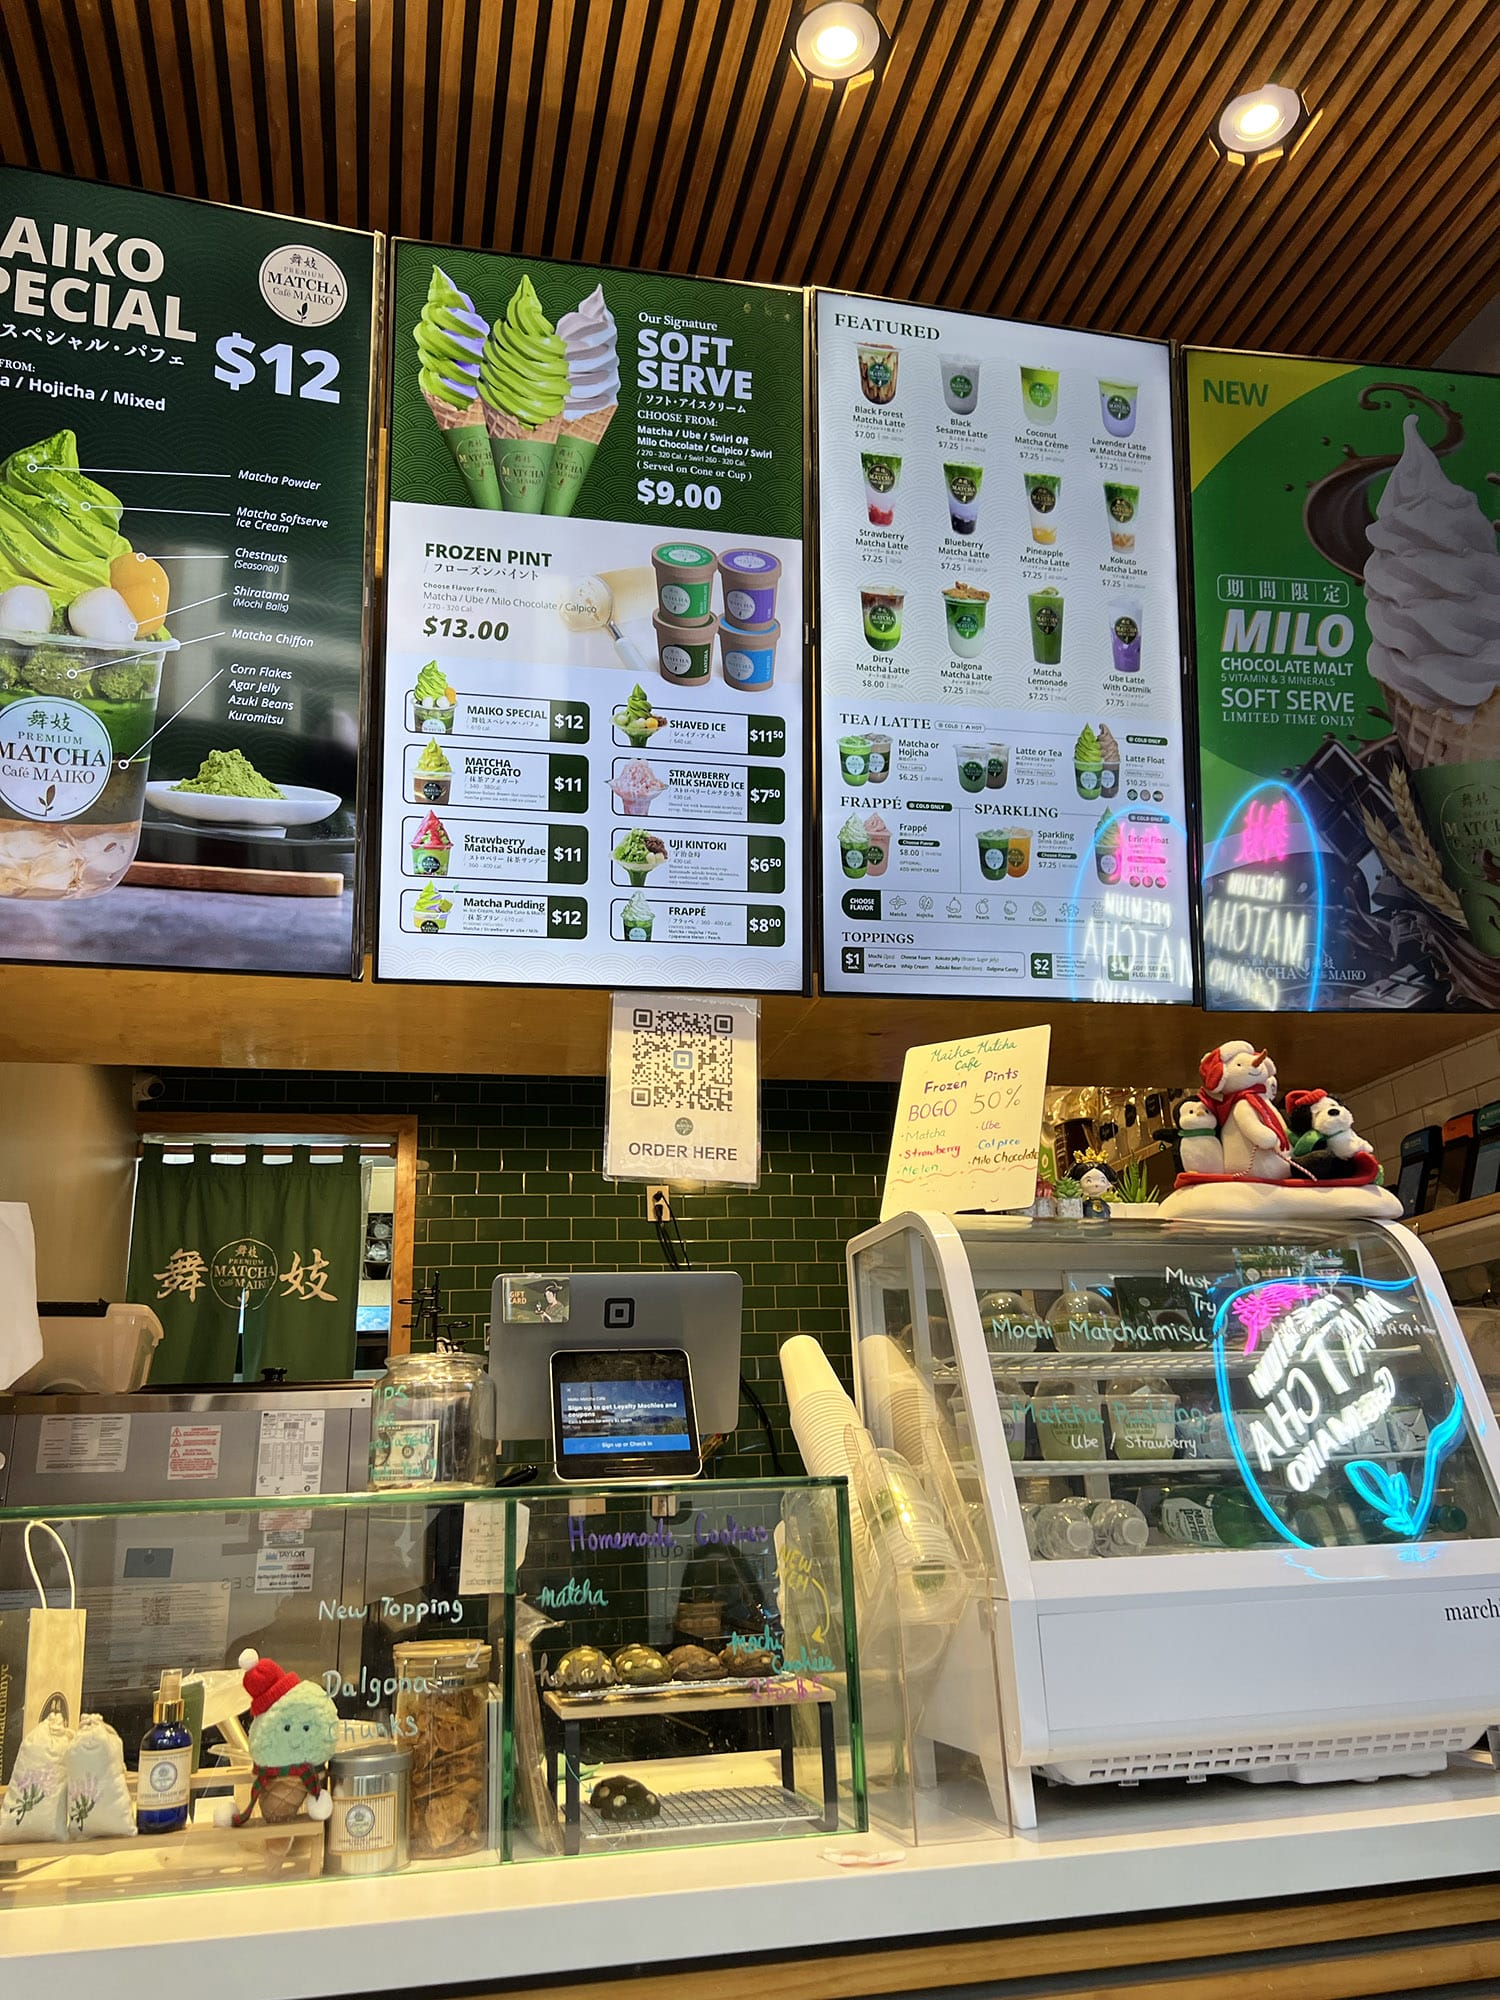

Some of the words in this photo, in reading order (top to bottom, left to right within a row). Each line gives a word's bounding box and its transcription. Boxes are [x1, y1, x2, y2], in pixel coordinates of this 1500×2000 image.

[283, 266, 324, 279] PREMIUM
[267, 271, 342, 297] MATCHA
[293, 290, 334, 306] MAIKO
[639, 312, 661, 324] Our
[664, 315, 718, 331] Signature
[835, 313, 940, 341] FEATURED
[637, 329, 733, 366] SOFT
[214, 332, 340, 404] $12
[637, 360, 752, 400] SERVE
[29, 378, 95, 401] Hojicha
[114, 390, 166, 412] Mixed
[1203, 378, 1269, 407] NEW
[855, 405, 877, 416] Black
[878, 409, 903, 419] Forest
[853, 415, 883, 426] Matcha
[884, 419, 906, 428] Latte
[950, 418, 971, 428] Black
[936, 426, 966, 437] Sesame
[967, 429, 988, 439] Latte
[1026, 428, 1057, 439] Coconut
[1092, 438, 1126, 449] Lavender
[1128, 442, 1147, 451] Latte
[238, 469, 279, 485] Matcha
[281, 475, 322, 490] Powder
[637, 478, 721, 510] $9.00
[236, 506, 277, 521] Matcha
[280, 510, 329, 529] Softserve
[236, 518, 252, 529] Ice
[254, 520, 289, 534] Cream
[859, 529, 905, 541] Strawberry
[855, 538, 886, 548] Matcha
[888, 542, 909, 551] Latte
[944, 538, 983, 550] Blueberry
[235, 548, 289, 564] Chestnuts
[425, 543, 501, 563] FROZEN
[507, 550, 552, 567] PINT
[1020, 556, 1048, 565] Matcha
[1050, 559, 1070, 568] Latte
[234, 558, 280, 574] (Seasonal)
[1099, 564, 1127, 574] Matcha
[1128, 567, 1148, 576] Latte
[233, 586, 290, 602] Shiratama
[232, 598, 264, 611] (Mochi
[265, 601, 289, 614] Balls)
[423, 615, 509, 642] $13.00
[1221, 608, 1354, 658] MILO
[232, 629, 273, 644] Matcha
[276, 633, 314, 648] Chiffon
[873, 655, 894, 665] Dirty
[950, 661, 982, 672] Dalgona
[1221, 656, 1310, 675] CHOCOLATE
[1314, 661, 1354, 677] MALT
[230, 663, 256, 677] Corn
[259, 666, 293, 680] Flakes
[856, 664, 887, 673] Matcha
[888, 666, 910, 675] Latte
[941, 670, 970, 680] Matcha
[972, 673, 993, 681] Latte
[1033, 668, 1062, 678] Matcha
[229, 679, 254, 693] Agar
[256, 681, 281, 696] Jelly
[1028, 677, 1068, 687] Lemonade
[1221, 673, 1227, 682] 5
[1229, 673, 1269, 684] VITAMIN
[1270, 675, 1278, 684] &
[1280, 675, 1286, 685] 3
[1288, 676, 1336, 687] MINERALS
[228, 695, 258, 708] Azuki
[261, 697, 294, 711] Beans
[1221, 687, 1280, 709] SOFT
[1286, 690, 1355, 713] SERVE
[228, 710, 284, 726] Kuromitsu
[467, 705, 504, 717] MAIKO
[506, 708, 548, 719] SPECIAL
[1222, 710, 1279, 724] LIMITED
[1283, 712, 1318, 725] TIME
[1320, 713, 1355, 727] ONLY
[554, 713, 584, 729] $12
[669, 720, 709, 731] SHAVED
[711, 723, 726, 732] ICE
[840, 713, 870, 726] TEA
[882, 716, 931, 730] LATTE
[17, 731, 83, 745] PREMIUM
[0, 741, 107, 767] MATCHA
[899, 749, 929, 758] Hojicha
[1125, 755, 1145, 763] Latte
[1147, 757, 1165, 765] Float
[465, 757, 511, 768] MATCHA
[2, 764, 30, 779] Café
[33, 767, 96, 785] MAIKO
[465, 766, 521, 777] AFFOGATO
[669, 769, 730, 780] STRAWBERRY
[554, 776, 582, 792] $11
[669, 777, 692, 786] MILK
[694, 779, 730, 789] SHAVED
[731, 782, 744, 790] ICE
[841, 796, 902, 810] FRAPPÉ
[974, 803, 1059, 819] SPARKLING
[900, 823, 927, 833] Frappé
[1038, 830, 1075, 841] Sparkling
[464, 834, 525, 847] Strawberry
[669, 840, 683, 849] UJI
[685, 841, 727, 851] KINTOKI
[464, 844, 505, 854] Matcha
[507, 845, 546, 856] Sundae
[553, 846, 581, 863] $11
[463, 898, 502, 908] Matcha
[504, 899, 545, 912] Pudding
[668, 906, 707, 916] FRAPPÉ
[552, 908, 582, 925] $12
[842, 931, 914, 944] TOPPINGS
[1328, 969, 1366, 981] MAIKO
[978, 1038, 1018, 1054] Matcha
[924, 1080, 967, 1094] Frozen
[984, 1067, 1019, 1083] Pints
[908, 1098, 957, 1122] BOGO
[969, 1084, 1023, 1115] 50%
[905, 1127, 946, 1142] Matcha
[981, 1120, 1002, 1131] Ube
[628, 1142, 688, 1158] ORDER
[694, 1146, 738, 1161] HERE
[905, 1144, 961, 1160] Strawberry
[902, 1164, 939, 1175] Melon
[973, 1155, 991, 1166] Milo
[993, 1149, 1039, 1165] Chocolate
[228, 1257, 264, 1266] PREMIUM
[153, 1247, 209, 1303] 舞
[213, 1265, 276, 1279] MATCHA
[1164, 1266, 1212, 1290] Must
[509, 1289, 525, 1298] GIFT
[1190, 1292, 1217, 1319] Try
[992, 1319, 1053, 1339] Mochi
[1068, 1320, 1210, 1343] Matchamisu
[1012, 1401, 1104, 1425] Matcha
[1071, 1434, 1099, 1449] Ube
[1125, 1435, 1197, 1458] Strawberry
[568, 1515, 677, 1552] Homemade
[695, 1512, 769, 1546] Cookies
[778, 1546, 813, 1573] NEW
[318, 1600, 368, 1621] New
[382, 1597, 464, 1624] Topping
[323, 1666, 433, 1708] Dalgona
